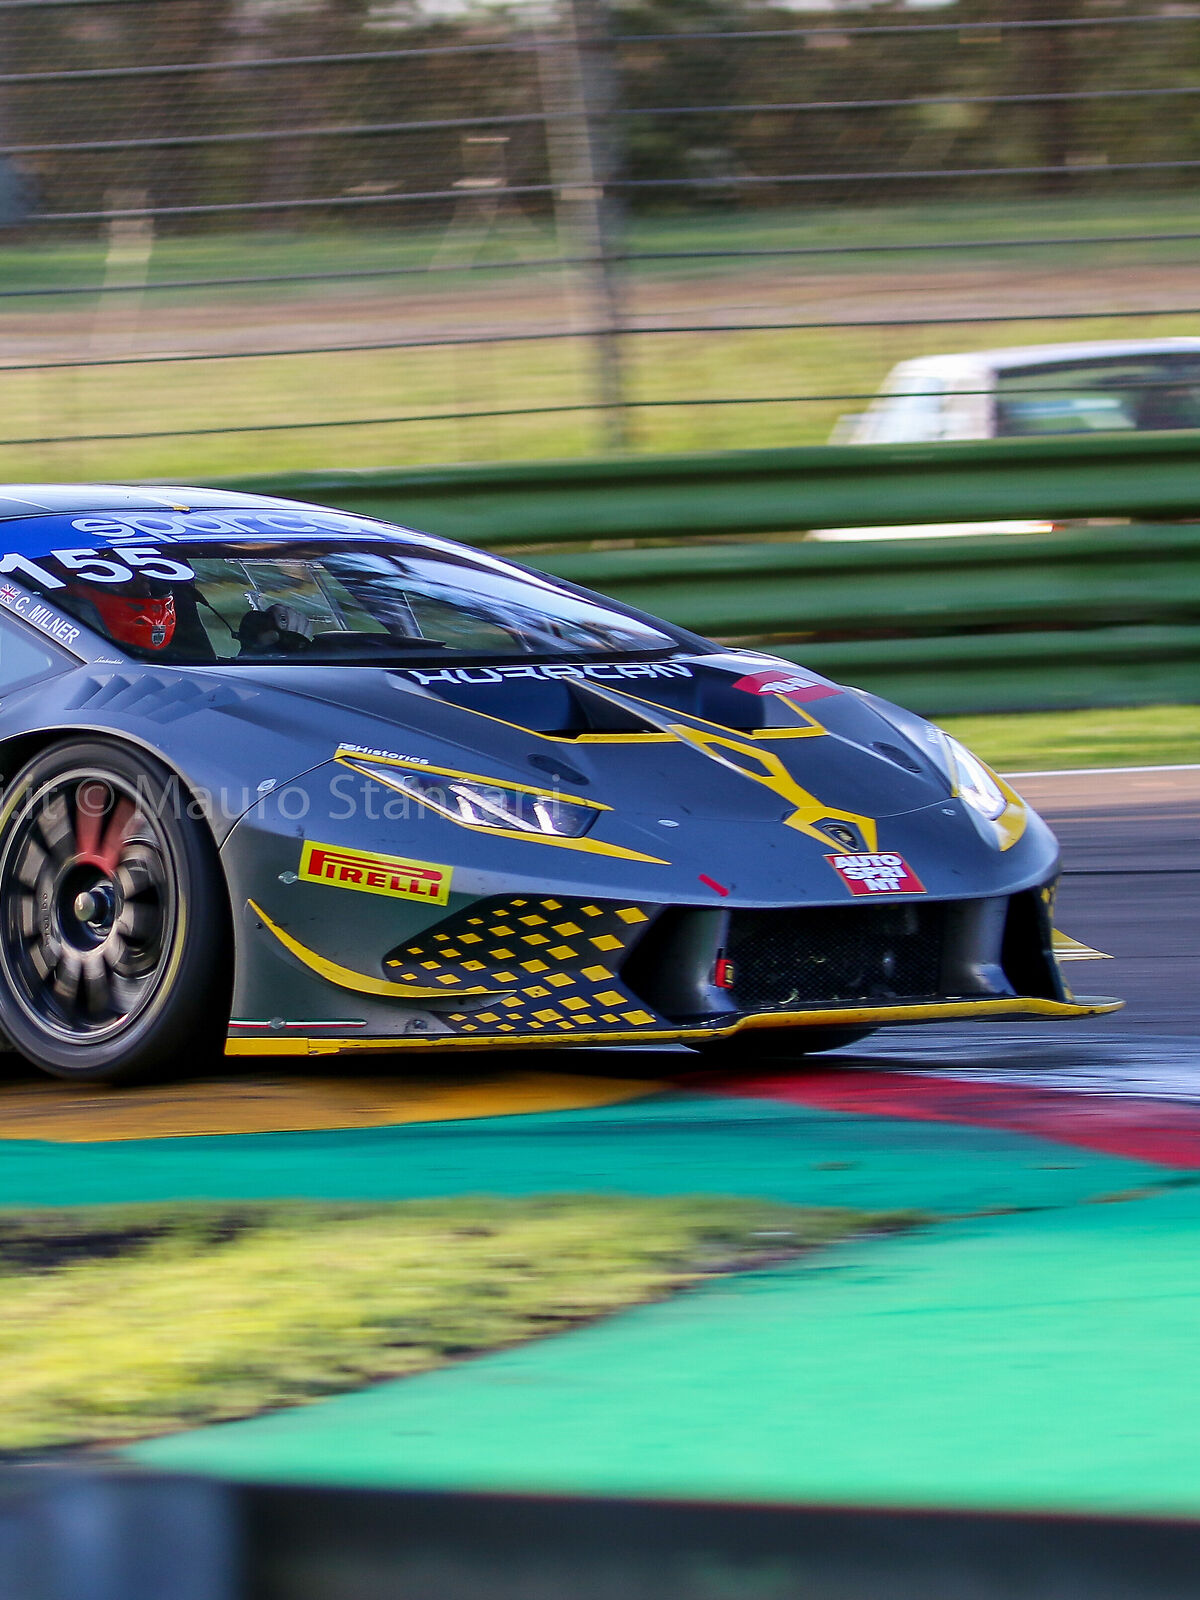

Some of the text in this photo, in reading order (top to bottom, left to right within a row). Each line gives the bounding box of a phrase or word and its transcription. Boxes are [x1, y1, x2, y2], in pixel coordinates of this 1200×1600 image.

[71, 510, 364, 545] sparco
[15, 597, 81, 644] C. MILNER
[408, 663, 693, 685] HURACAN
[308, 848, 443, 897] PIRELLI
[834, 854, 903, 869] AUTO
[843, 866, 908, 880] SPRI
[864, 877, 901, 891] NT
